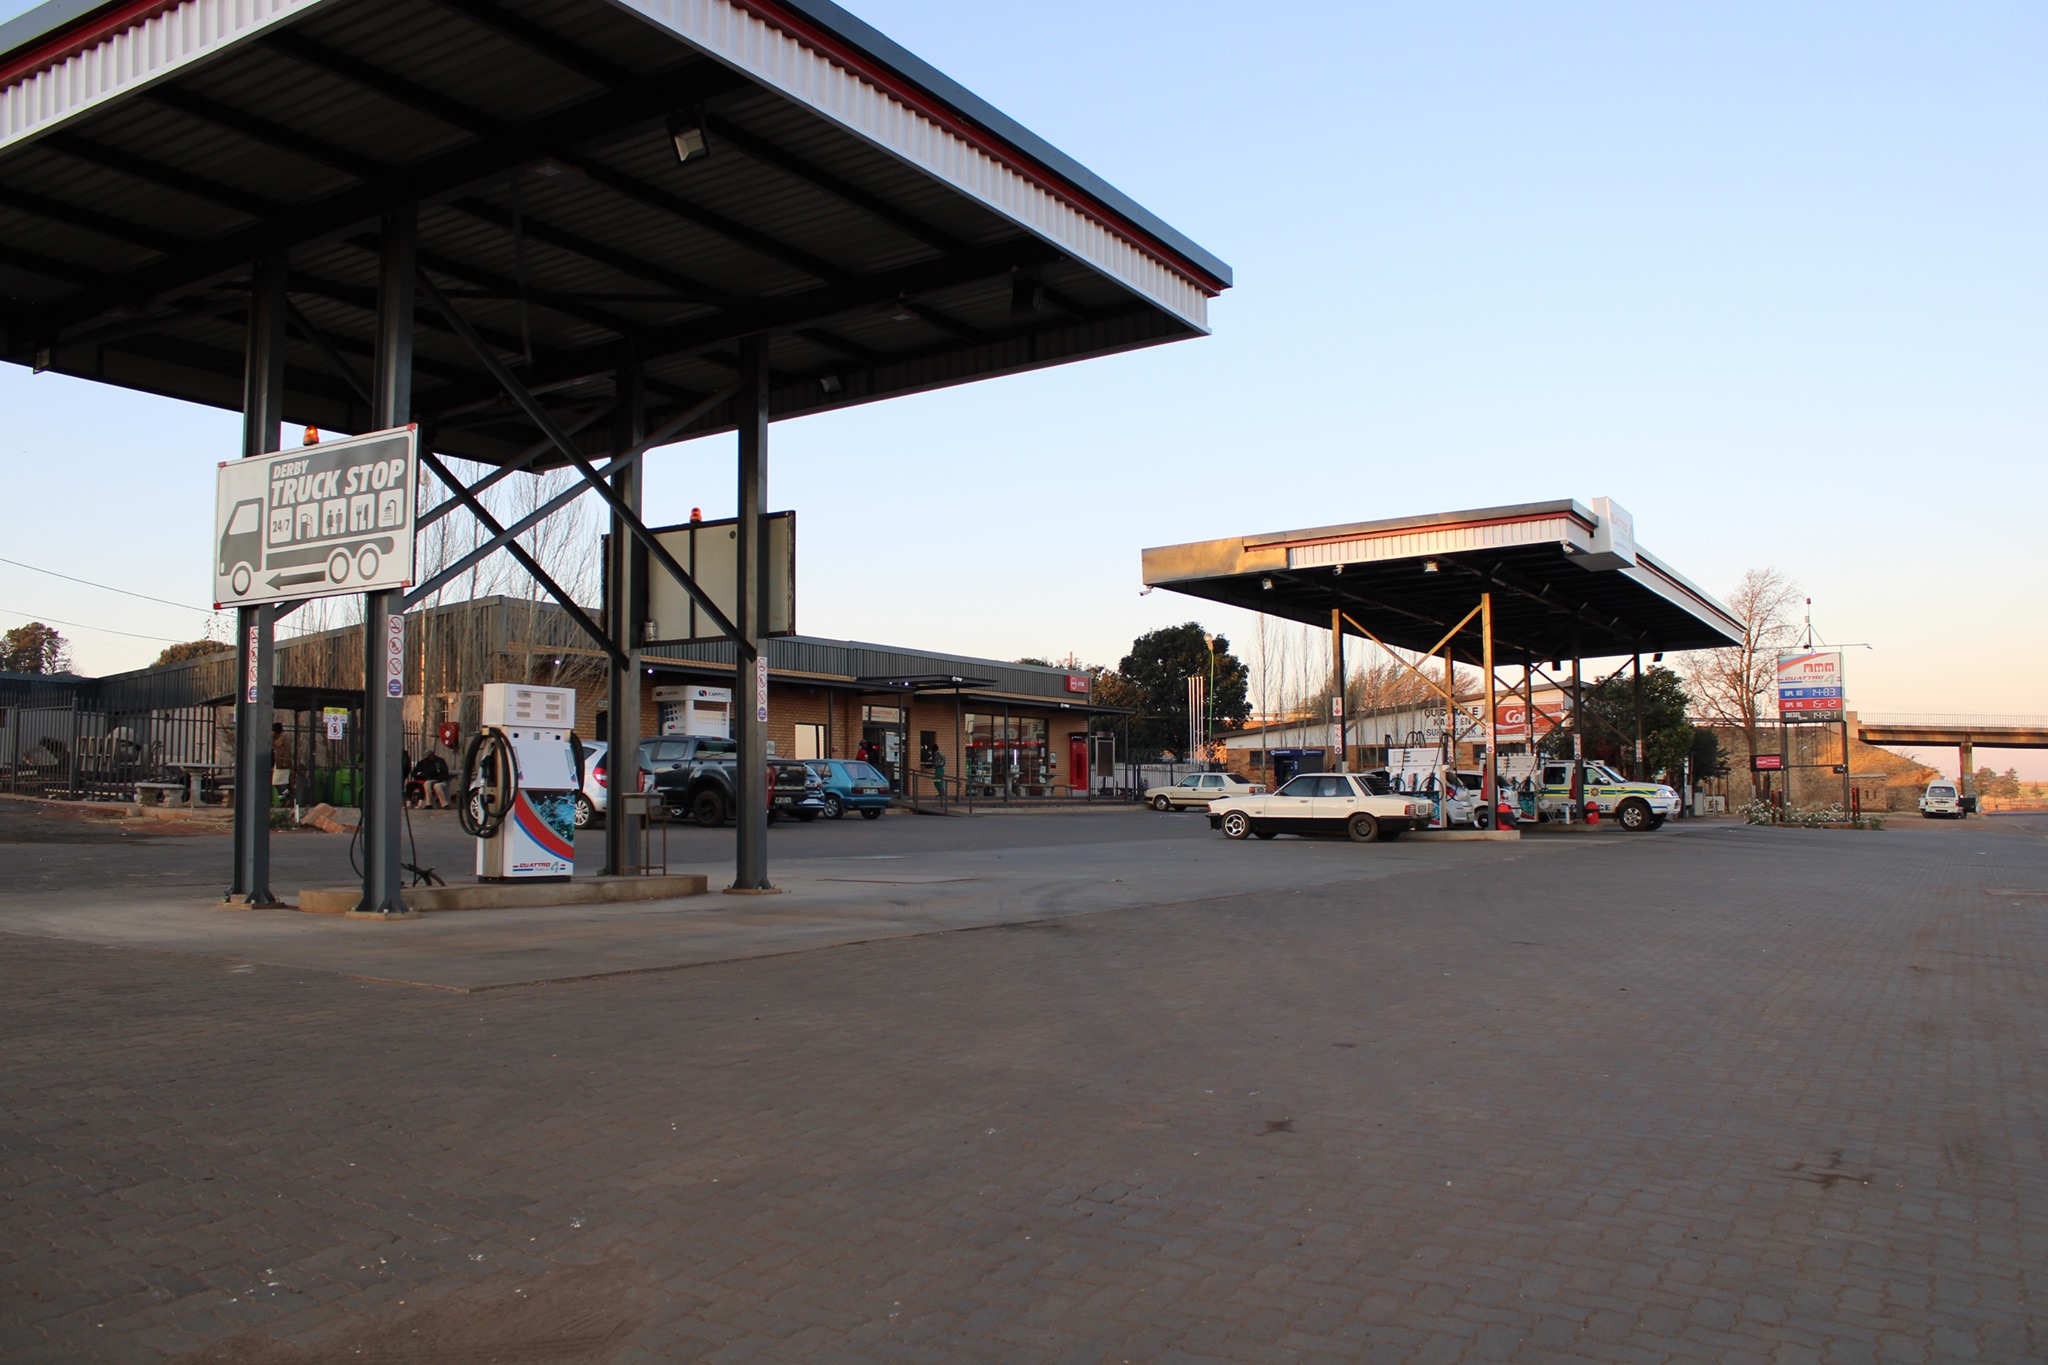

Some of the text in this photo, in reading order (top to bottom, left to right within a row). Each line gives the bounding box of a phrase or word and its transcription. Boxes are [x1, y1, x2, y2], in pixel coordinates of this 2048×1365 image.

[273, 460, 309, 480] DERBY
[271, 459, 405, 507] TRUCK STOP
[272, 518, 290, 533] 24/7
